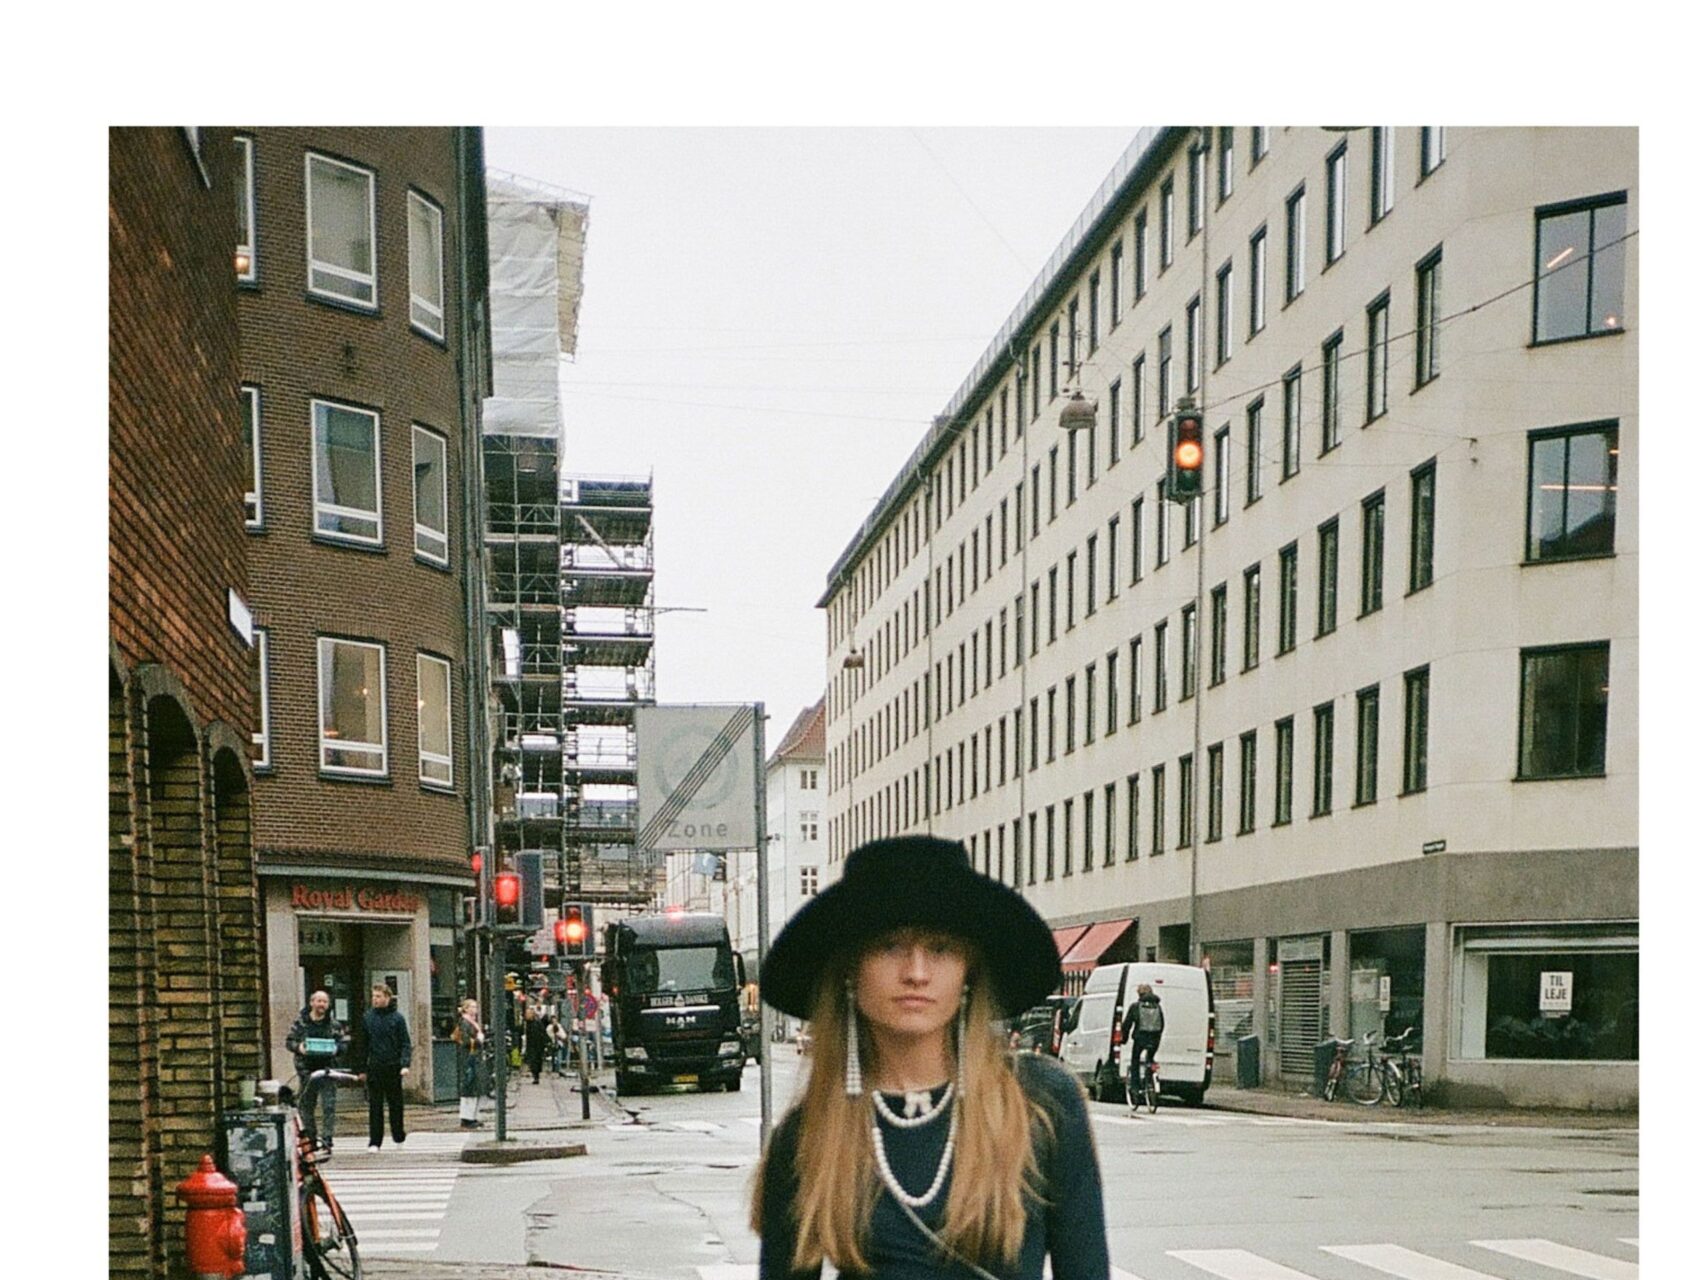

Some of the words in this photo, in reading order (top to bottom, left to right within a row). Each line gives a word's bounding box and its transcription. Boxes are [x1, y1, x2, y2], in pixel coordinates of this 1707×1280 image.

[667, 820, 728, 838] Zone
[291, 884, 353, 910] Royal
[1549, 975, 1563, 986] TIL
[1545, 988, 1567, 999] LEJE
[666, 1016, 696, 1025] MAN
